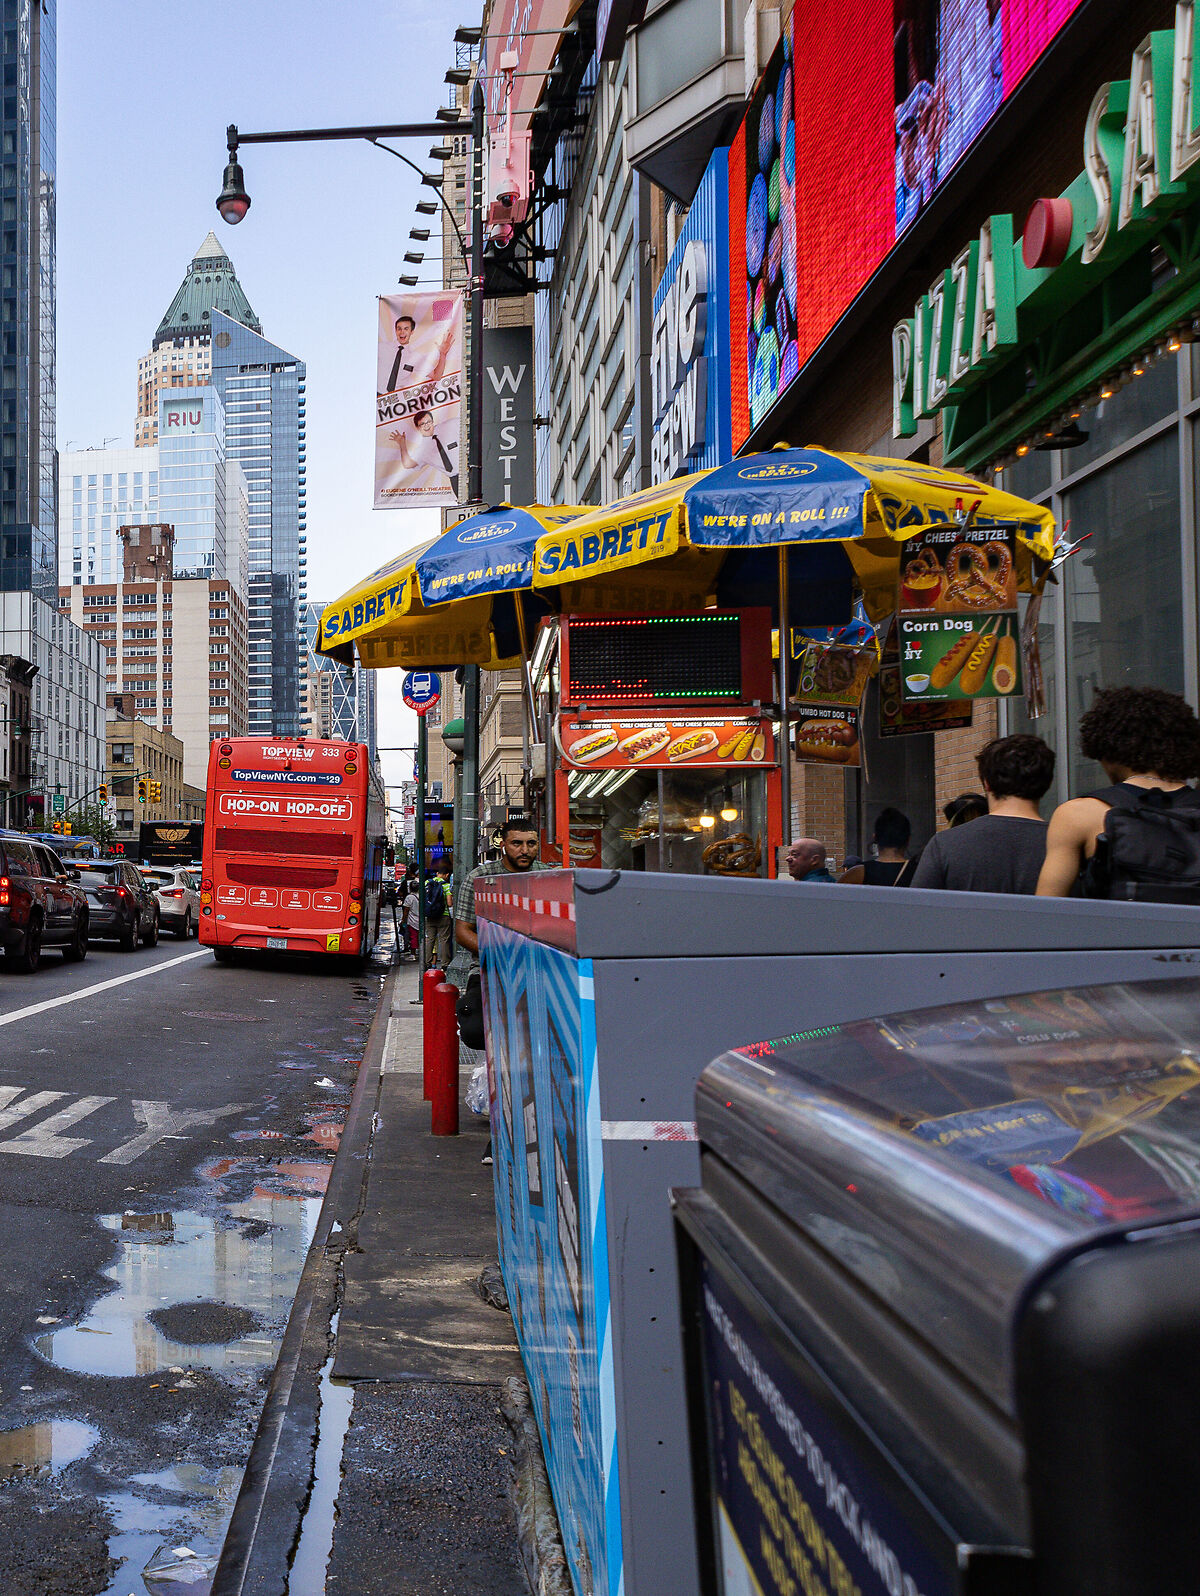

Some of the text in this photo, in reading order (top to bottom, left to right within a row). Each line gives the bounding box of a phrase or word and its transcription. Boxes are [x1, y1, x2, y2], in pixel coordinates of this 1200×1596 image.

[892, 214, 1012, 438] PIZZA
[377, 375, 458, 407] THE BOOK OF
[377, 385, 461, 421] MORMON
[168, 411, 201, 426] RIU
[486, 364, 527, 505] WESTI
[703, 515, 748, 528] WE'RE
[752, 512, 773, 526] ON
[775, 511, 785, 524] A
[790, 508, 826, 523] ROLL
[538, 507, 674, 575] SABRETT
[925, 529, 1009, 544] CHEES PRETZEL
[431, 573, 465, 590] WE'RE
[467, 569, 483, 581] ON
[485, 567, 494, 577] A
[496, 563, 524, 576] ROLL
[323, 579, 407, 639] SABRETT
[903, 619, 973, 633] Corn Dog
[904, 650, 923, 660] NY
[405, 694, 438, 709] NO STANDING
[800, 708, 845, 719] UMBO HOT DOG
[261, 746, 315, 758] TOPVIEW
[321, 747, 340, 757] 333
[233, 770, 317, 784] TopViewNYC.com
[326, 775, 341, 784] $29
[227, 798, 346, 816] HOP-ON HOP-OFF
